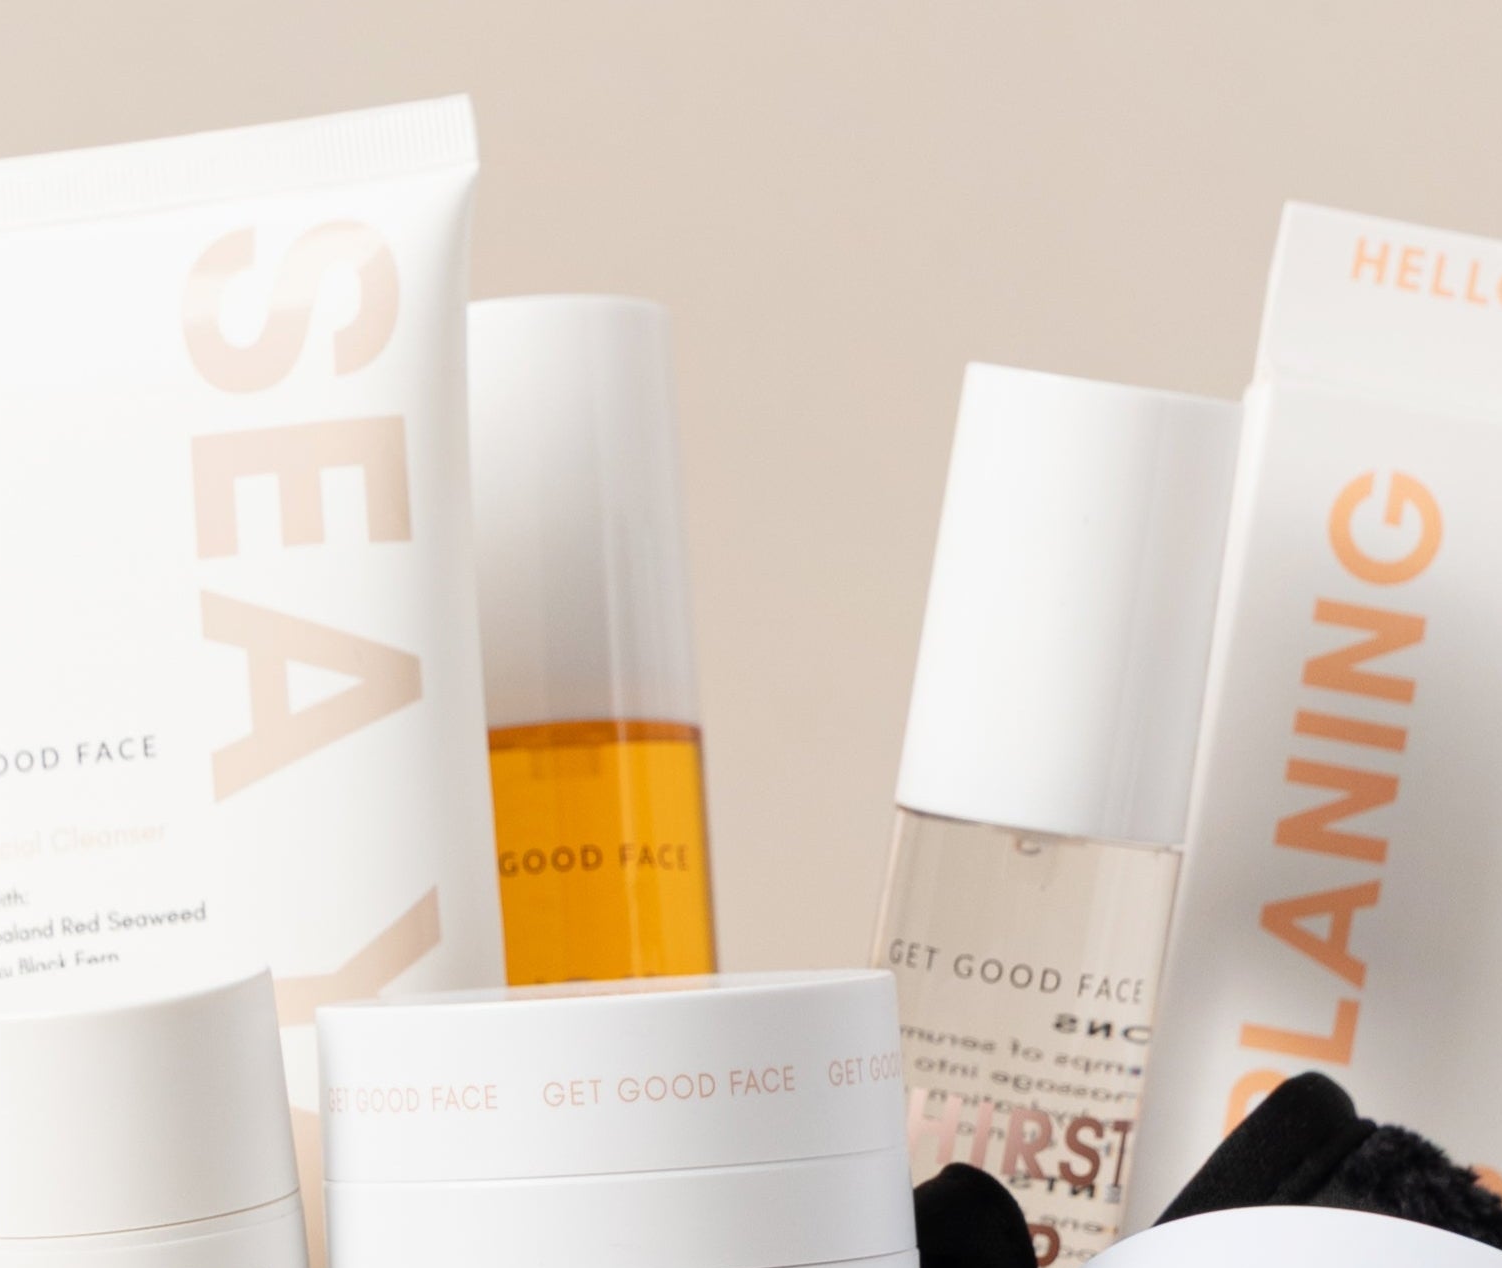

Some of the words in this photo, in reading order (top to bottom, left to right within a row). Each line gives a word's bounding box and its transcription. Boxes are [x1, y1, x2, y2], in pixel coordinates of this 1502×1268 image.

[181, 219, 423, 804] SEA
[76, 735, 157, 766] FACE
[50, 823, 166, 856] Cleanser
[498, 843, 604, 878] GOOD
[618, 842, 690, 872] FACE
[61, 914, 101, 935] Red
[108, 899, 207, 930] Seaweed
[889, 938, 941, 972] GET
[953, 953, 1062, 994] GOOD
[1077, 973, 1145, 1004] FACE
[543, 1079, 602, 1108] GET
[617, 1073, 716, 1103] GOOD
[729, 1065, 795, 1097] FACE
[828, 1057, 864, 1087] GET
[869, 1051, 902, 1082] GOO
[355, 1087, 421, 1113] GOOD
[431, 1084, 499, 1113] FACE
[907, 1086, 1134, 1188] HIRST
